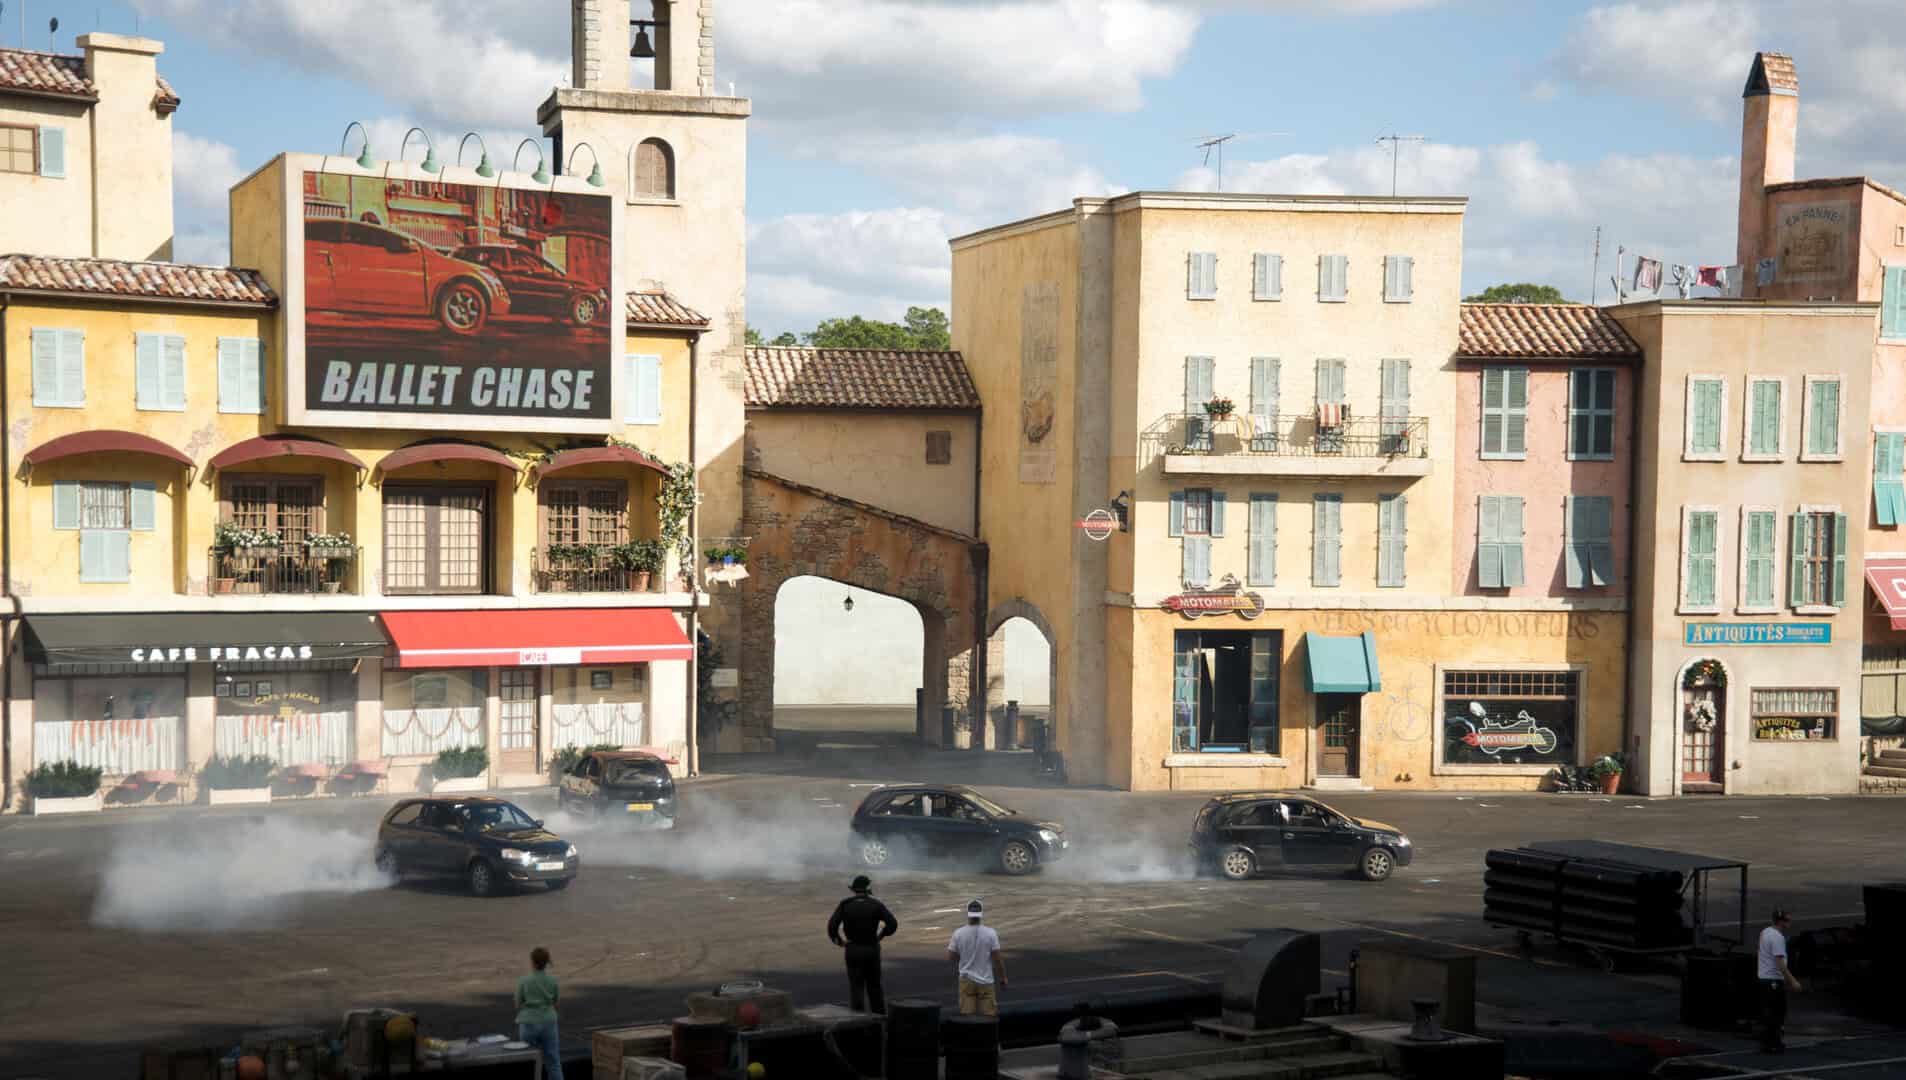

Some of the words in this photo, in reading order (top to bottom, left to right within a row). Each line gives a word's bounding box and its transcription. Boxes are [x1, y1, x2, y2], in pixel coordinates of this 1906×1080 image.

[320, 359, 462, 406] BALLET
[470, 366, 594, 410] CHASE
[209, 646, 313, 661] FRACAS
